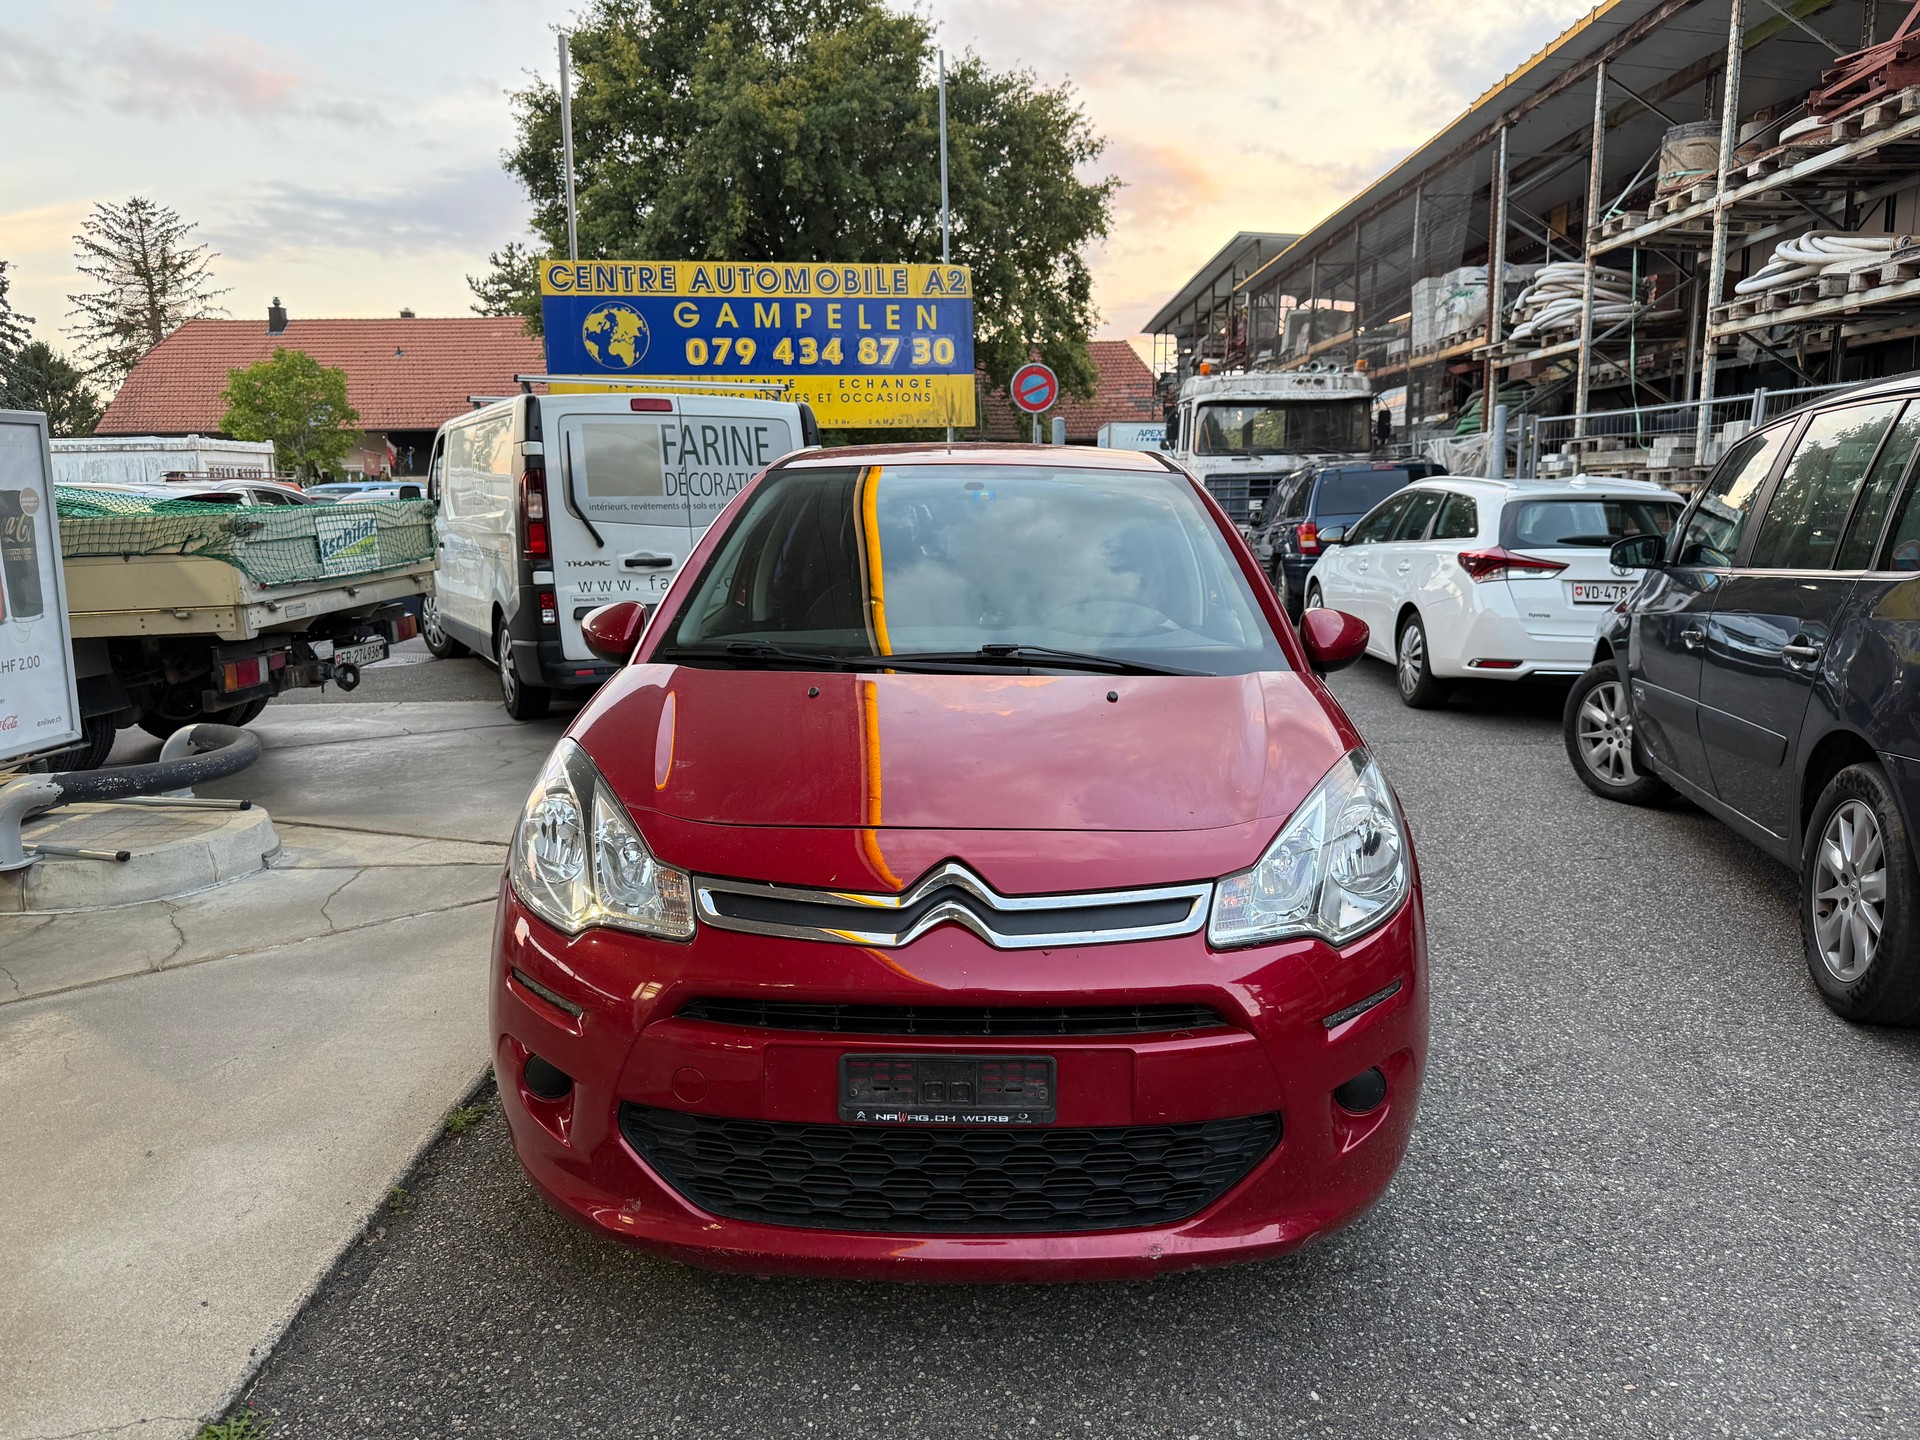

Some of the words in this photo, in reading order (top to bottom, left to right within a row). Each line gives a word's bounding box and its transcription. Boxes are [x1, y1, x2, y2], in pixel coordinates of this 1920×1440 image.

[546, 264, 676, 293] CENTRE
[688, 265, 909, 295] AUTOMOBILE
[922, 267, 968, 295] A2
[673, 301, 938, 330] GAMPELEN
[686, 337, 757, 365] 079
[773, 337, 844, 365] 434
[857, 338, 899, 365] 87
[912, 337, 955, 365] 30
[839, 378, 932, 389] ECHANGE
[818, 393, 832, 403] ET
[840, 392, 931, 403] OCCASIONS
[661, 424, 772, 466] FARINE
[631, 502, 679, 511] revêtements
[681, 502, 691, 510] de
[693, 501, 707, 510] sols
[0, 660, 16, 674] HF
[18, 655, 41, 671] 2.00
[875, 1111, 956, 1122] NAWAG.CH
